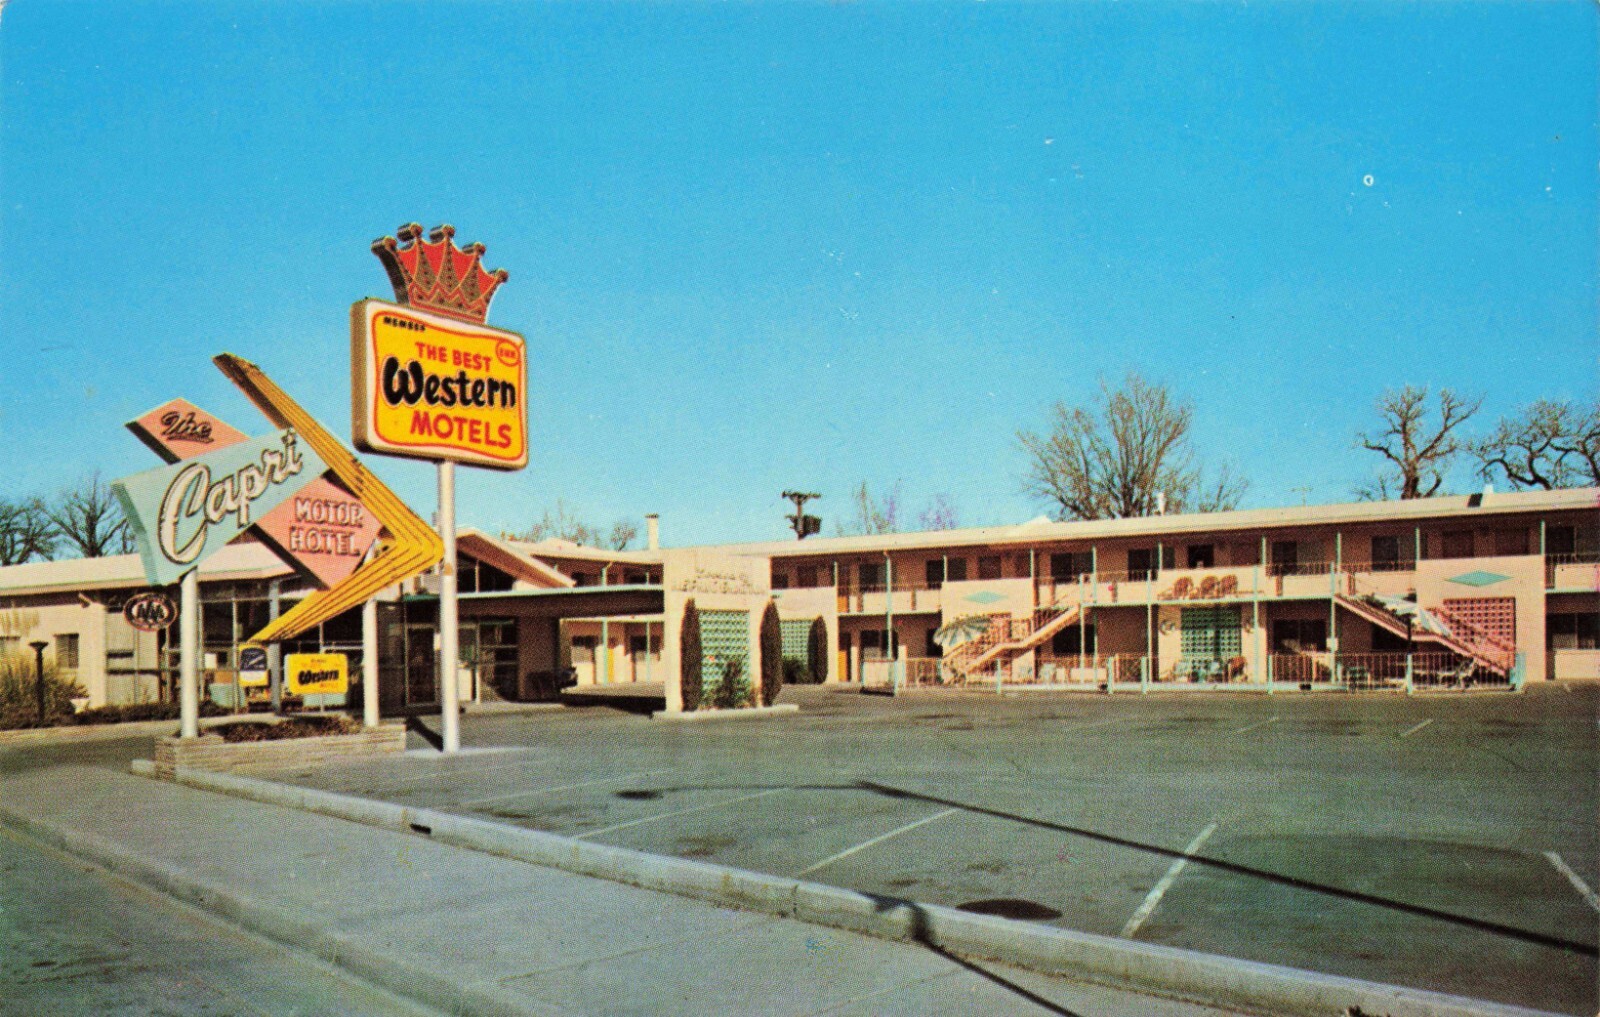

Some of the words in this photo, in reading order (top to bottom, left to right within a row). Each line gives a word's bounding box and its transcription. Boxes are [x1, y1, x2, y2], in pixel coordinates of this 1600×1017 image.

[415, 342, 448, 363] THE
[452, 349, 492, 372] BEST
[383, 356, 516, 408] Western
[160, 411, 214, 444] The
[410, 410, 512, 448] MOTELS
[158, 427, 303, 565] Capri
[294, 498, 364, 528] MOTOR
[289, 526, 361, 556] HOTEL
